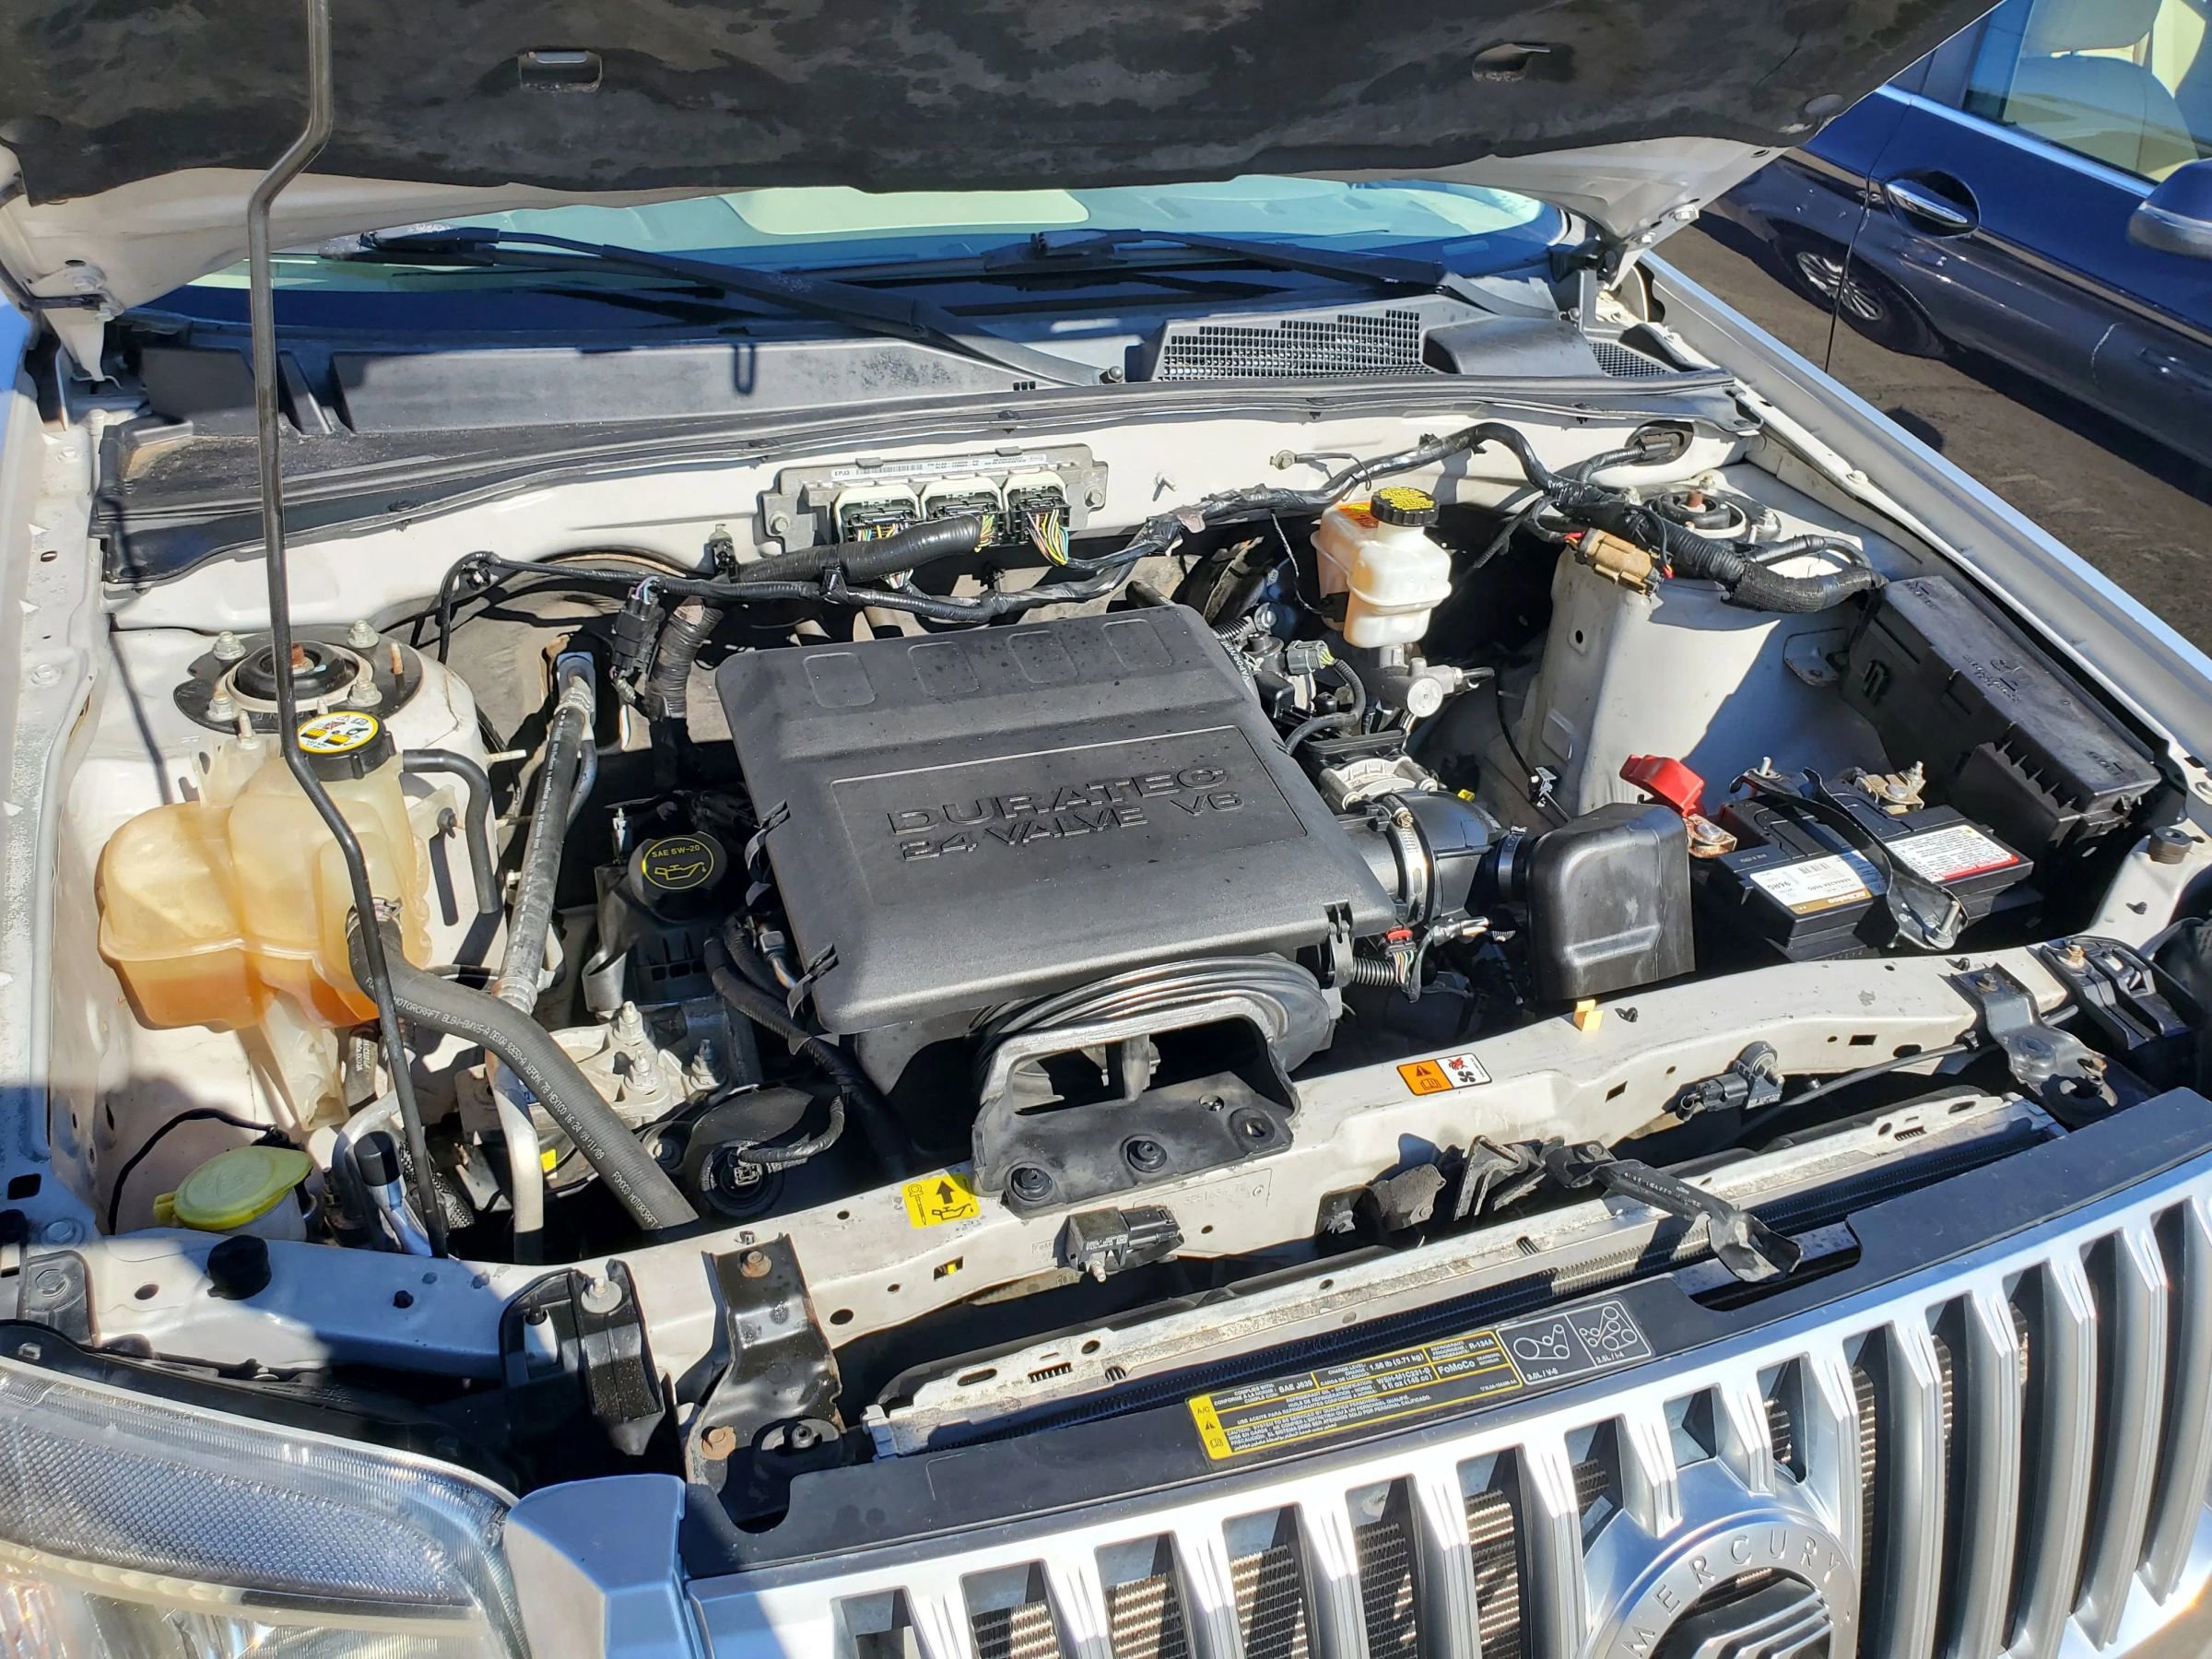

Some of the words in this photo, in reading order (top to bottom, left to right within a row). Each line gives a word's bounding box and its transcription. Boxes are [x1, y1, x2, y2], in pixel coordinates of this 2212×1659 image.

[1221, 641, 1250, 682] VAPOR/VENT
[887, 766, 1229, 836] DURATEC
[900, 831, 978, 862] 24
[985, 806, 1148, 845] VALVE
[1171, 791, 1244, 817] V6
[652, 850, 669, 858] SAE
[671, 844, 700, 854] 5W-20
[547, 1090, 567, 1116] MEXICO
[1468, 1337, 1494, 1349] R-134A
[1411, 1352, 1425, 1362] kg)
[1438, 1359, 1476, 1374] FoMoCo
[1278, 1383, 1295, 1393] SAE
[1196, 1406, 1210, 1414] A/C
[1621, 1529, 1840, 1659] MERCURY
